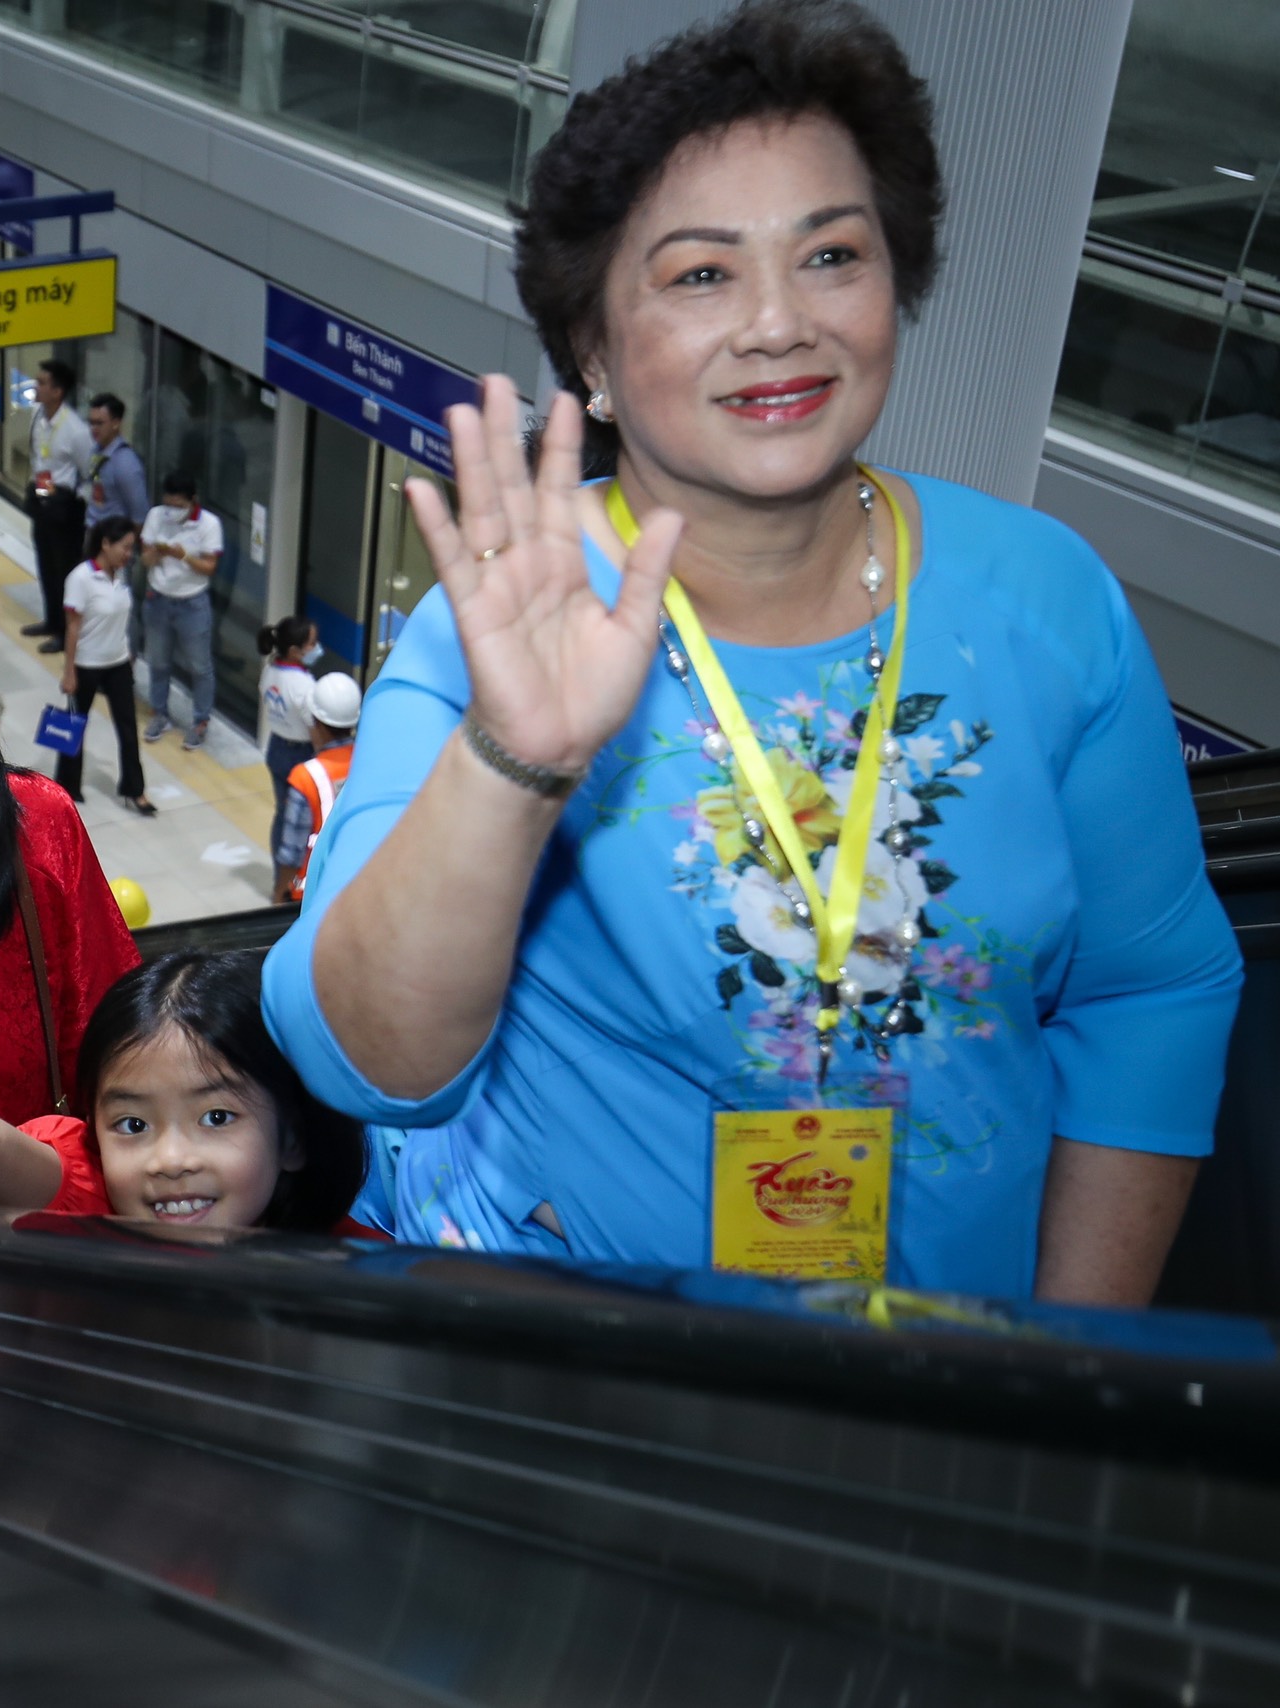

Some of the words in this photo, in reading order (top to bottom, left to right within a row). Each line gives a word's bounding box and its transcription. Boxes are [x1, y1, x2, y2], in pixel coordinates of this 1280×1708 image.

[25, 277, 76, 304] máy
[345, 331, 367, 358] Bến
[368, 341, 404, 376] Thành
